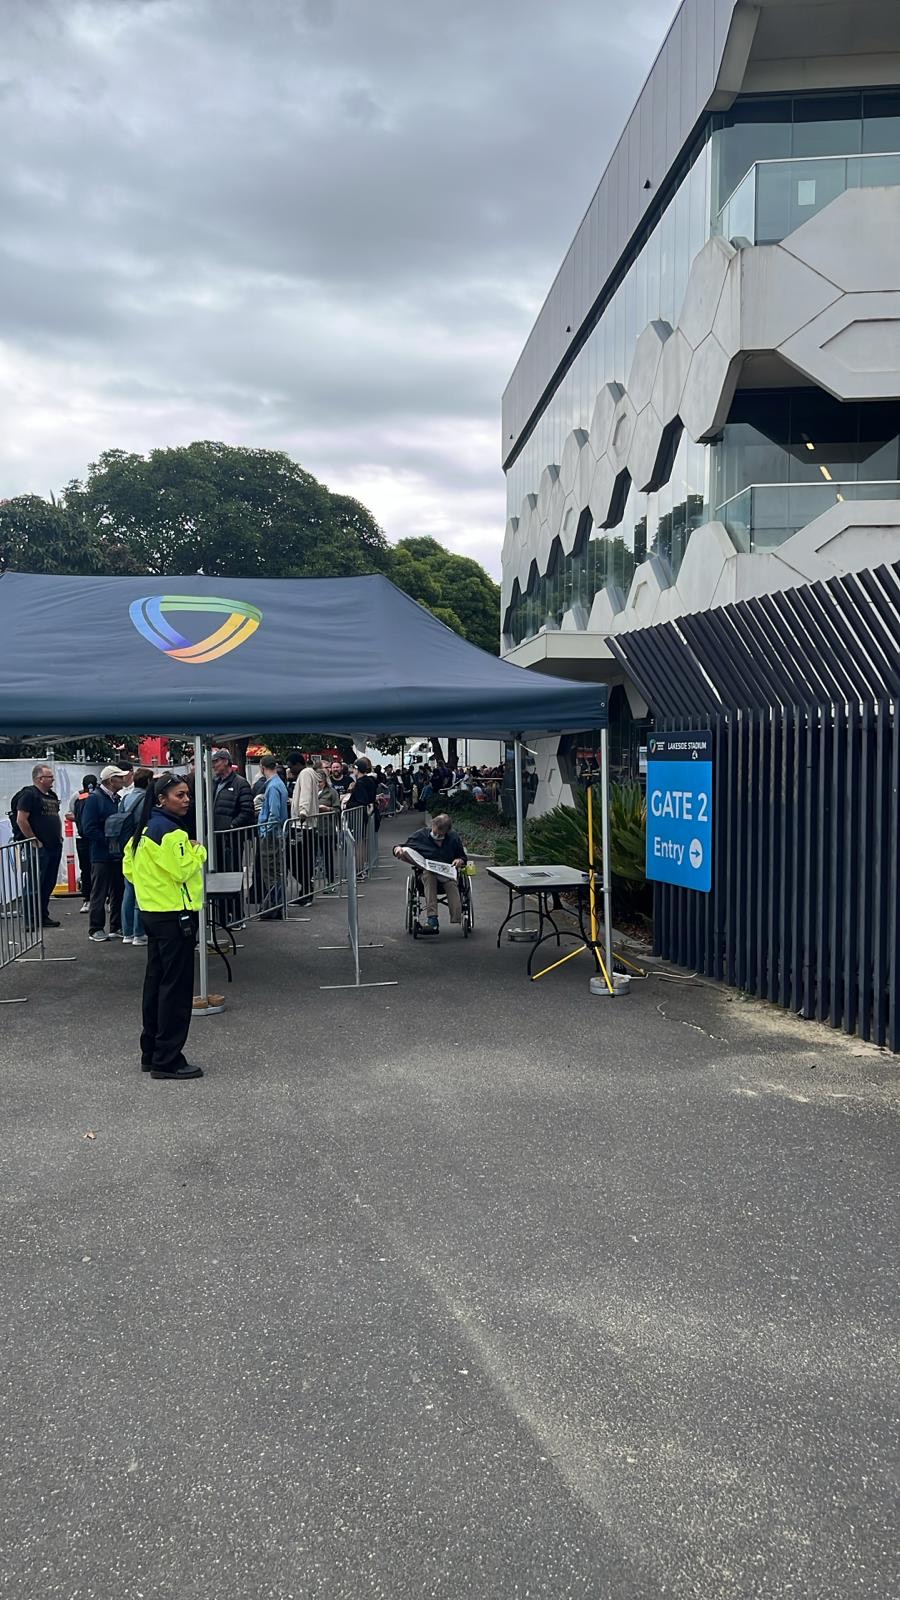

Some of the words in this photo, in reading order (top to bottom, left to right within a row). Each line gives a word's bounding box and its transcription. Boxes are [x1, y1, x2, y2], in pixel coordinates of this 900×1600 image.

[667, 742, 687, 750] LAKESIDE
[688, 742, 707, 750] STADIUM
[651, 790, 692, 820] GATE
[698, 792, 708, 822] 2
[654, 836, 684, 865] Entry
